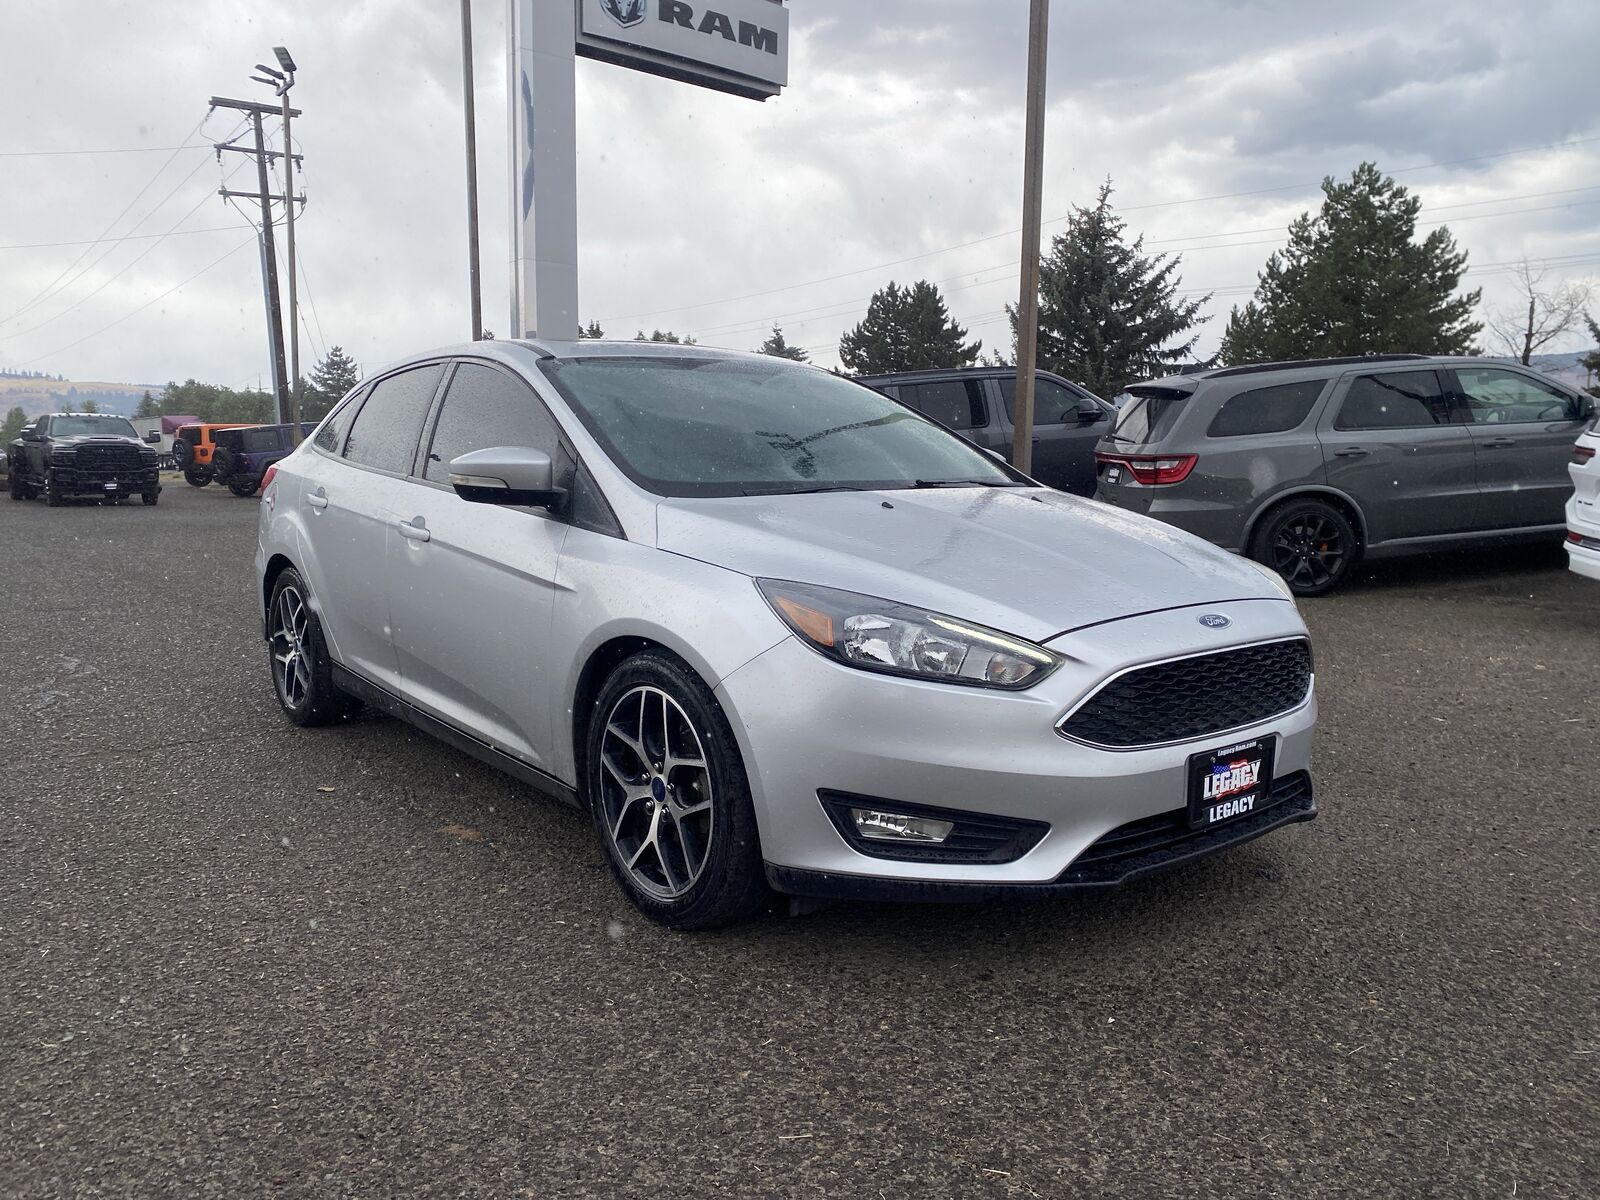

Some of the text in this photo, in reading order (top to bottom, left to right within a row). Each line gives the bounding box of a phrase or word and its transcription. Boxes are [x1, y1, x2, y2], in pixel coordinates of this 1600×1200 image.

[658, 0, 778, 55] RAM
[1204, 615, 1226, 626] Ford
[1203, 760, 1261, 799] LEGACY
[1209, 795, 1255, 823] LEGACY
